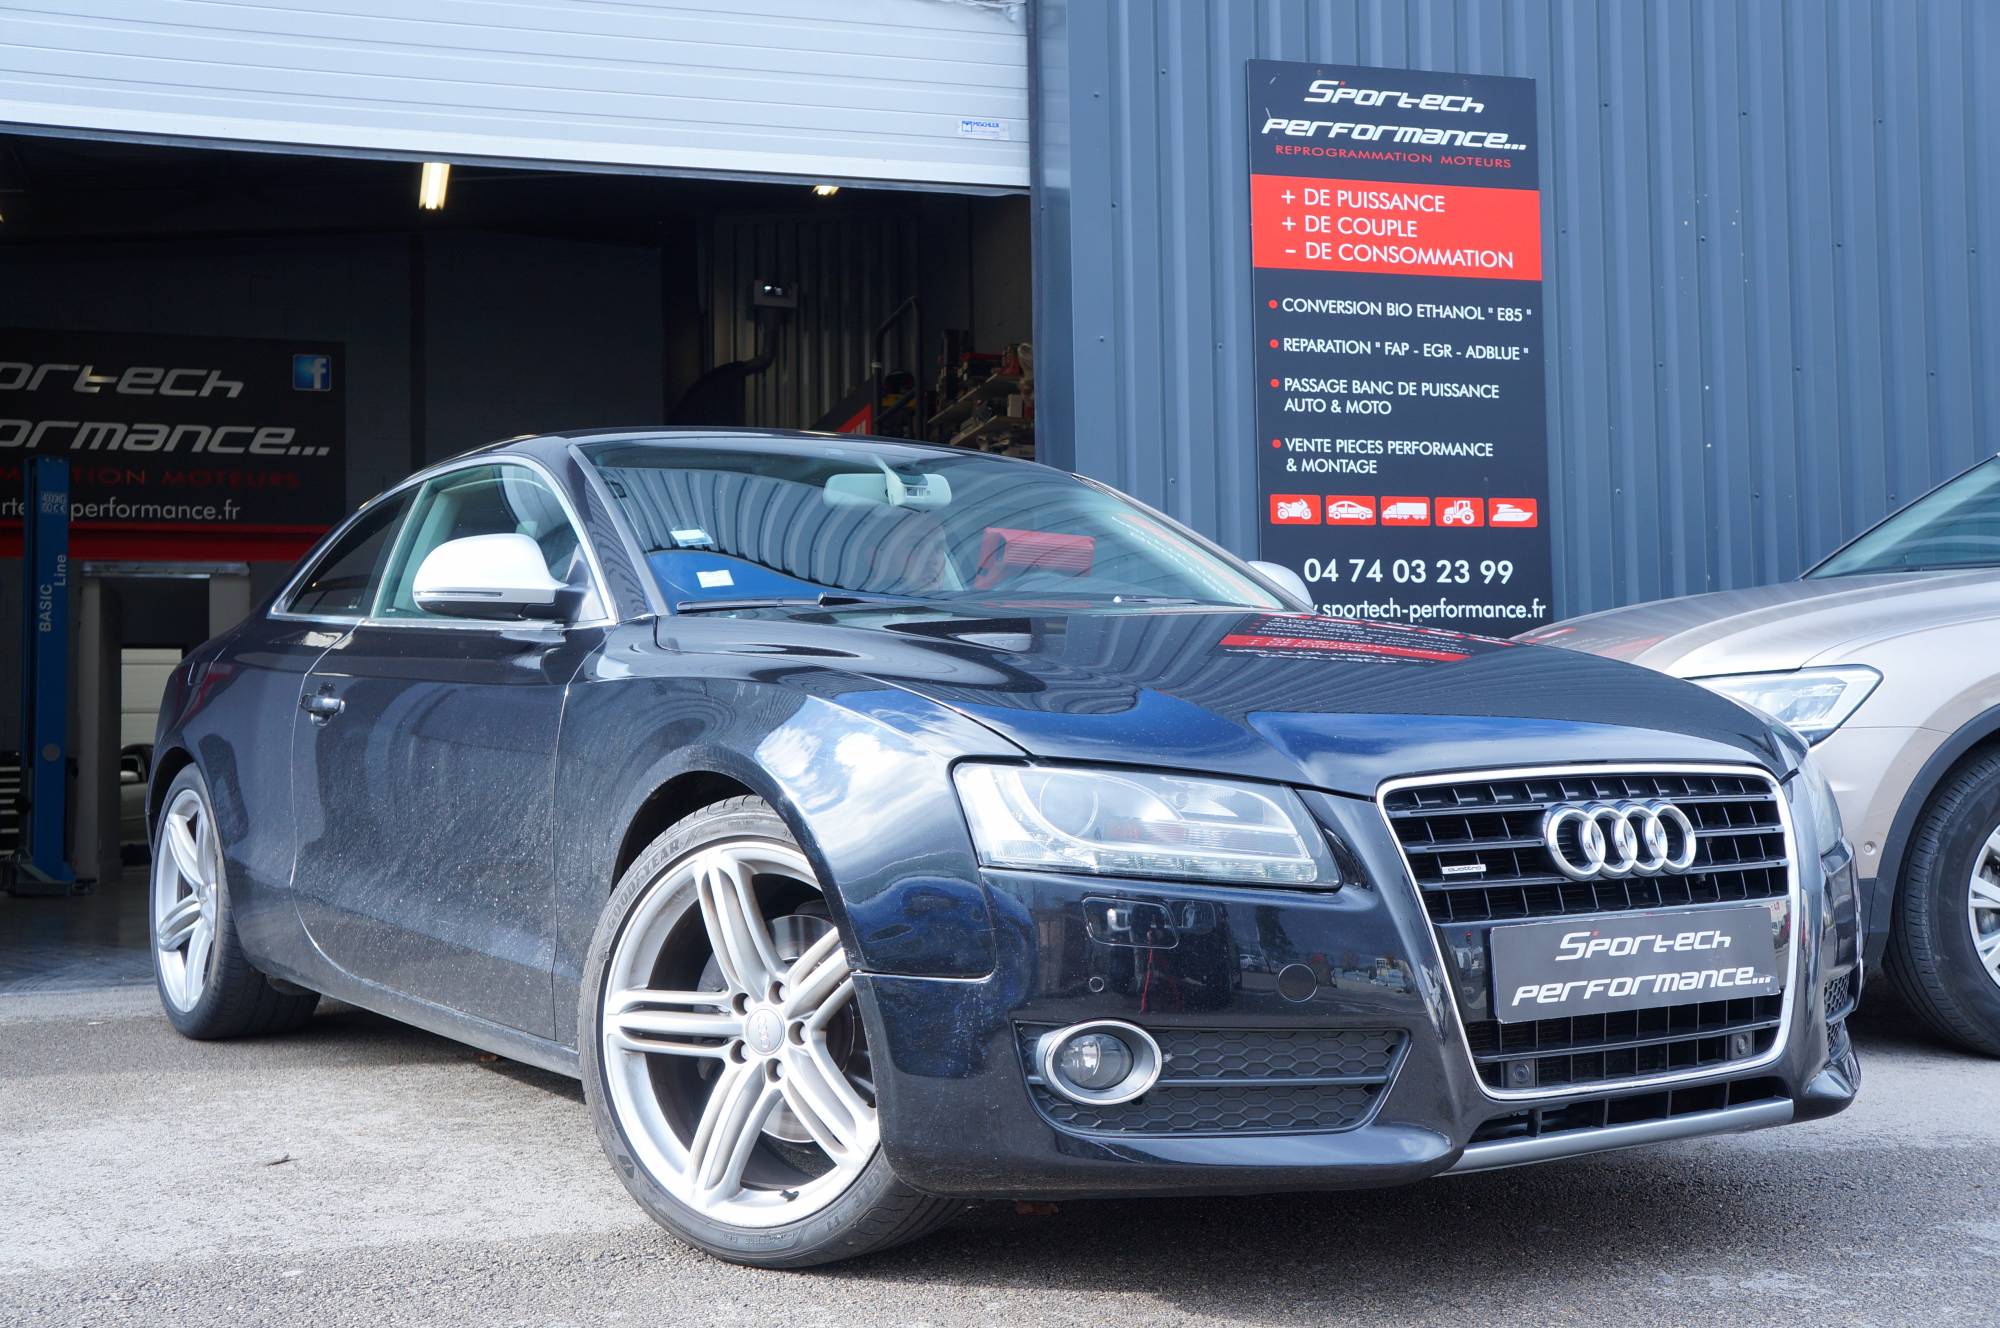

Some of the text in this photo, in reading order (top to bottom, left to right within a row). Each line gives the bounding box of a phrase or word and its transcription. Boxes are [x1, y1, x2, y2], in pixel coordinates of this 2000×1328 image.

[1304, 79, 1485, 113] Sportech
[1275, 145, 1511, 168] REPROGRAMMATION MOTEURS
[1304, 188, 1330, 206] DE
[1336, 190, 1446, 212] PUISSANCE
[1304, 215, 1331, 233] DE
[1337, 217, 1417, 238] COUPLE
[1305, 242, 1332, 260] DE
[1338, 243, 1514, 269] CONSOMMATION
[1282, 298, 1382, 316] CONVERSION
[1386, 302, 1412, 317] BIO
[1416, 304, 1485, 321] ETHANOL
[1283, 338, 1371, 355] REPARATION
[1384, 342, 1409, 356] FAP
[1423, 343, 1453, 358] EGR
[1465, 345, 1520, 361] ADBLUE
[1284, 377, 1500, 399] PASSAGE BANC DE PUISSANCE
[1284, 398, 1392, 415] AUTO & MOTO
[1285, 438, 1493, 457] VENTE PIECES PERFORMANCE
[1286, 458, 1377, 474] & MONTAGE
[53, 553, 67, 587] Line
[1303, 558, 1513, 585] 04 74 03 23 99
[39, 584, 53, 632] BASIC
[1555, 930, 1732, 961] Sportech
